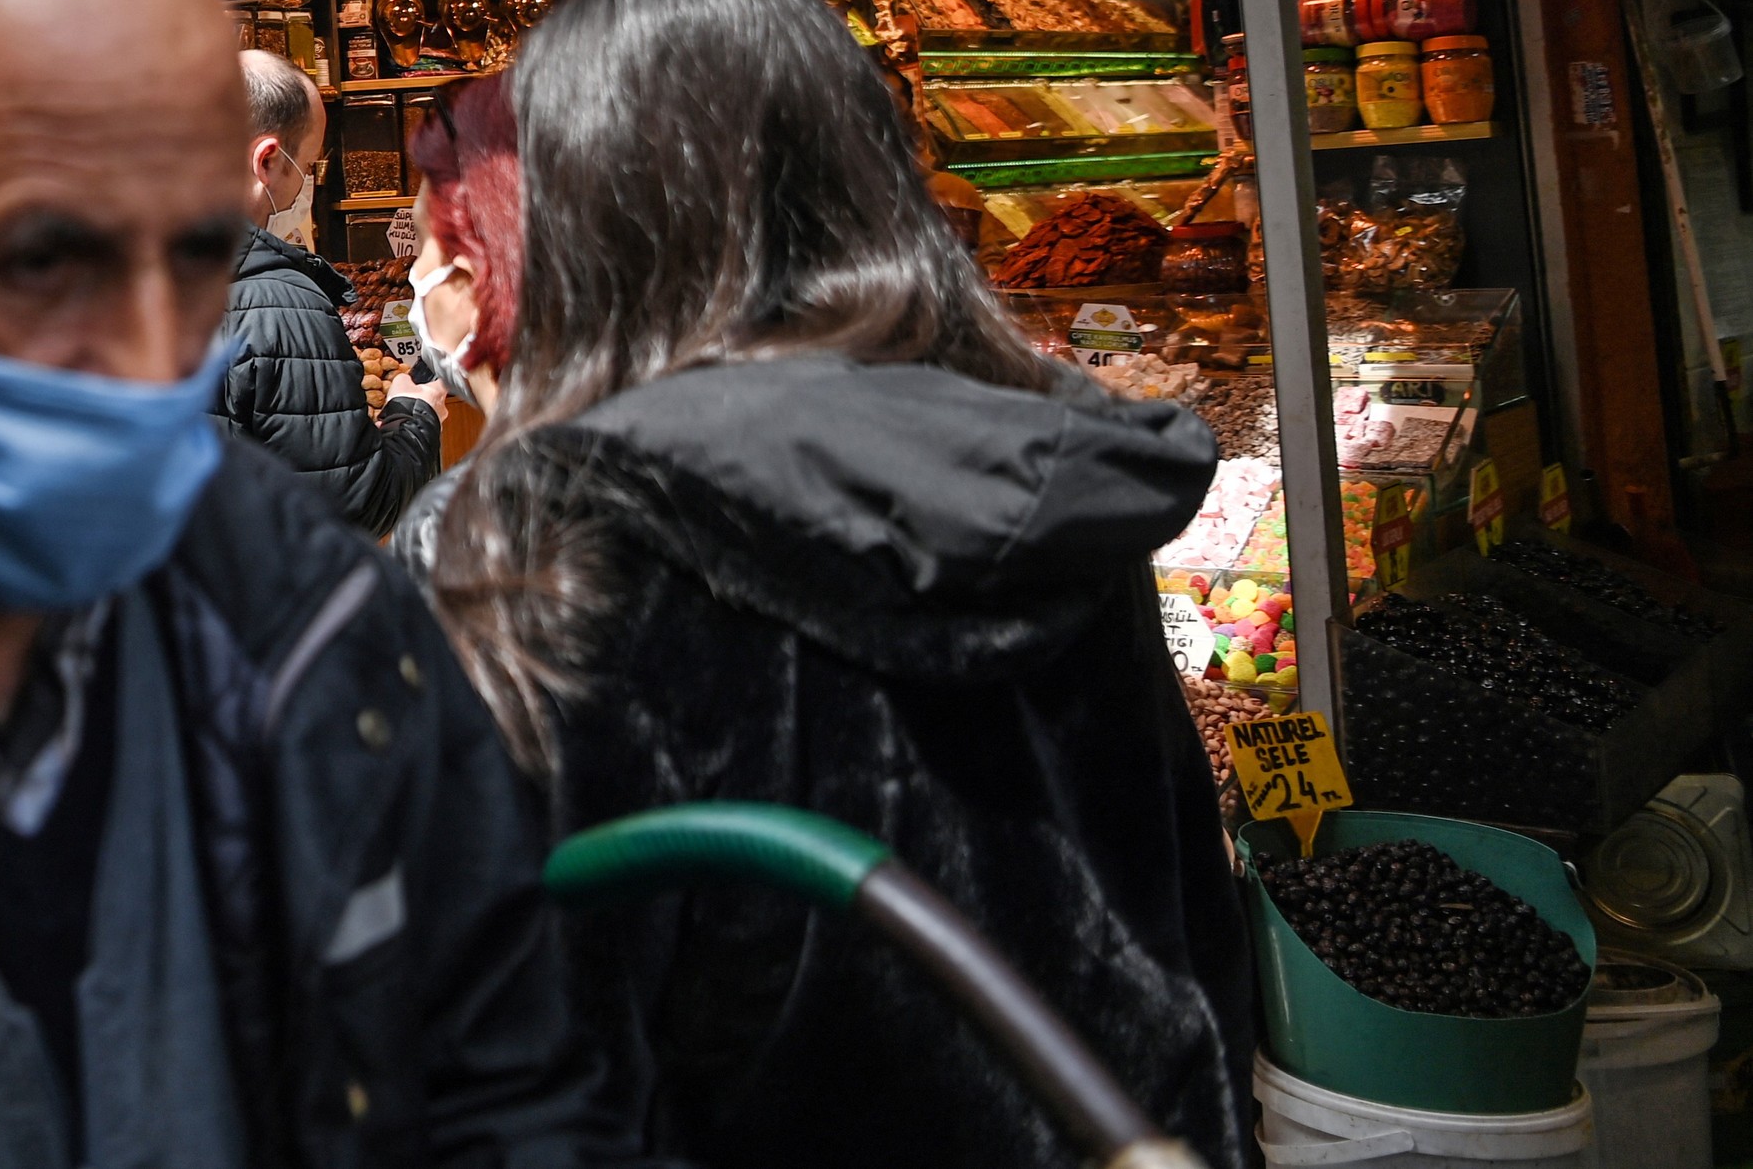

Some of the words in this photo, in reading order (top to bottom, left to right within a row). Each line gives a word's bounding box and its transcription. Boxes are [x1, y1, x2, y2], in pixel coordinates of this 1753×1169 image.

[393, 221, 415, 231] JUMB
[1232, 716, 1326, 749] NATUREL
[1255, 743, 1310, 773] SELE
[1272, 770, 1318, 812] 24
